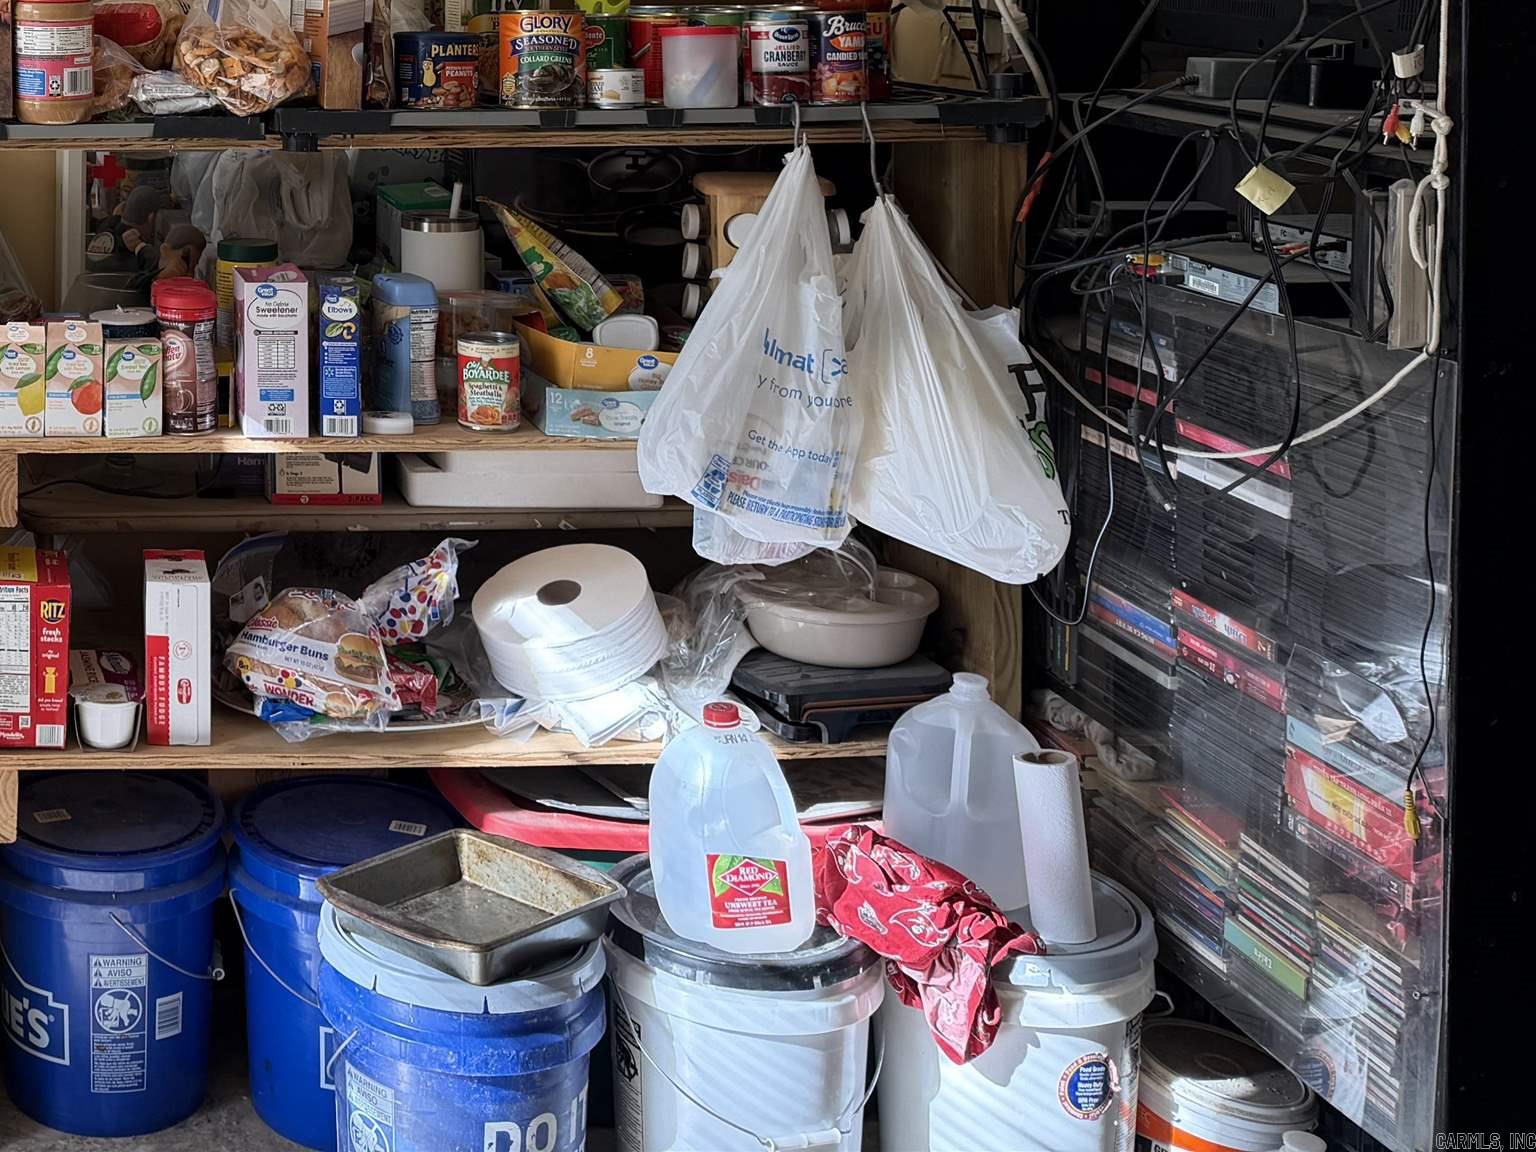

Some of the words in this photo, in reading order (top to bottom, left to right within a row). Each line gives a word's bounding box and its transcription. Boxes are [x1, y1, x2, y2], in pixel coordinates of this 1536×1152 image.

[520, 16, 574, 33] GLORY
[515, 35, 577, 50] SEASONED
[764, 51, 806, 62] CRANBERRY
[586, 347, 593, 359] 8
[464, 367, 511, 382] BOYARDEE
[469, 383, 496, 392] Spaghetti
[769, 378, 802, 401] from
[550, 392, 563, 404] 12
[747, 429, 767, 446] Get
[768, 439, 783, 452] the
[727, 490, 747, 511] PLEASE
[40, 600, 65, 618] RITZ
[42, 627, 61, 637] fresh
[40, 635, 63, 643] stacks
[241, 631, 300, 652] Hamburger
[300, 647, 329, 661] Buns
[158, 655, 166, 692] FAMOUS
[264, 684, 315, 706] WONDER
[158, 696, 166, 725] FUDGE
[739, 866, 759, 876] RED
[726, 873, 773, 883] DIAMOND
[725, 901, 762, 910] UNSWEET
[763, 899, 779, 908] TEA
[103, 958, 142, 967] WARNING
[107, 968, 132, 977] AVISO
[103, 978, 145, 988] AVERTISSEMENT
[484, 1112, 557, 1152] DO
